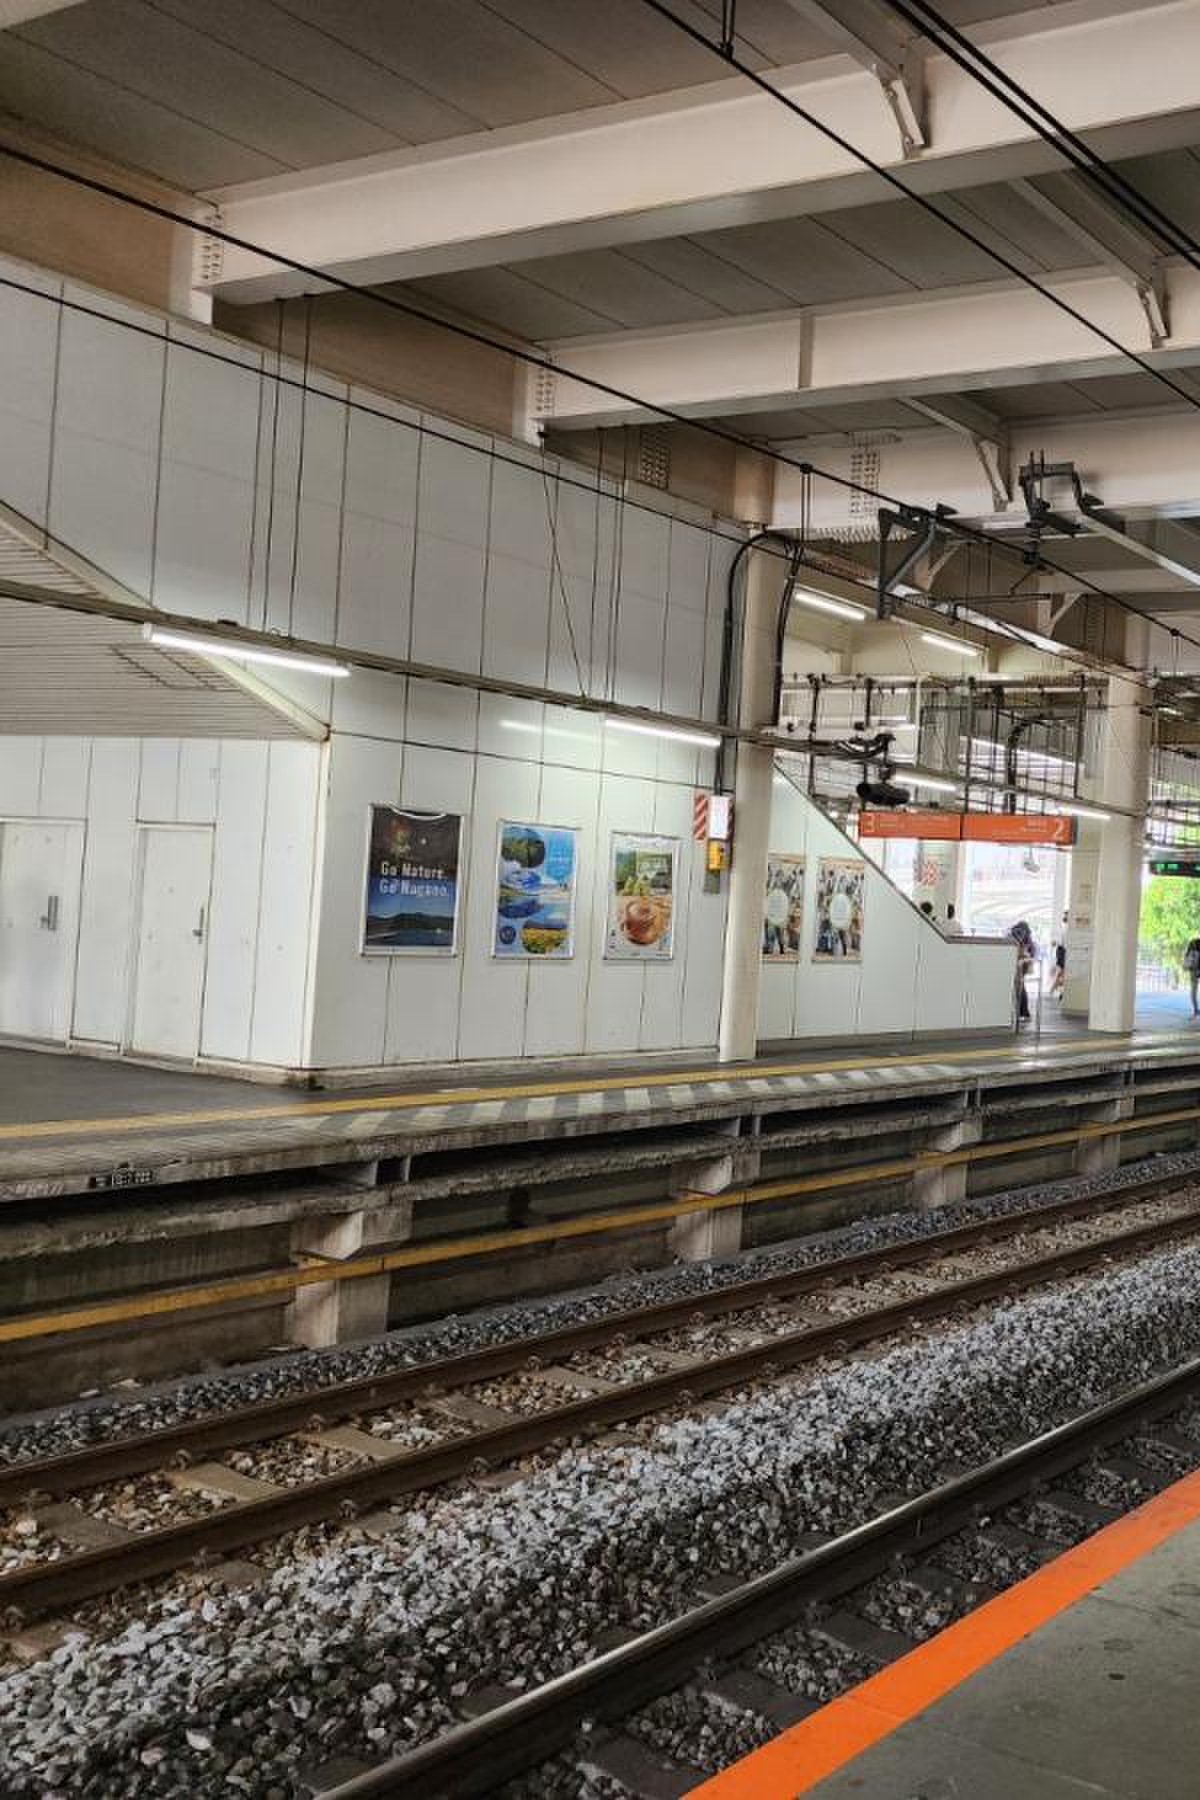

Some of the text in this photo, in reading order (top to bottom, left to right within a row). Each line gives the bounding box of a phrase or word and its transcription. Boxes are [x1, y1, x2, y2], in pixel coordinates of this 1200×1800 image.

[1053, 819, 1066, 840] 2
[381, 861, 398, 877] Go
[380, 879, 398, 895] Go
